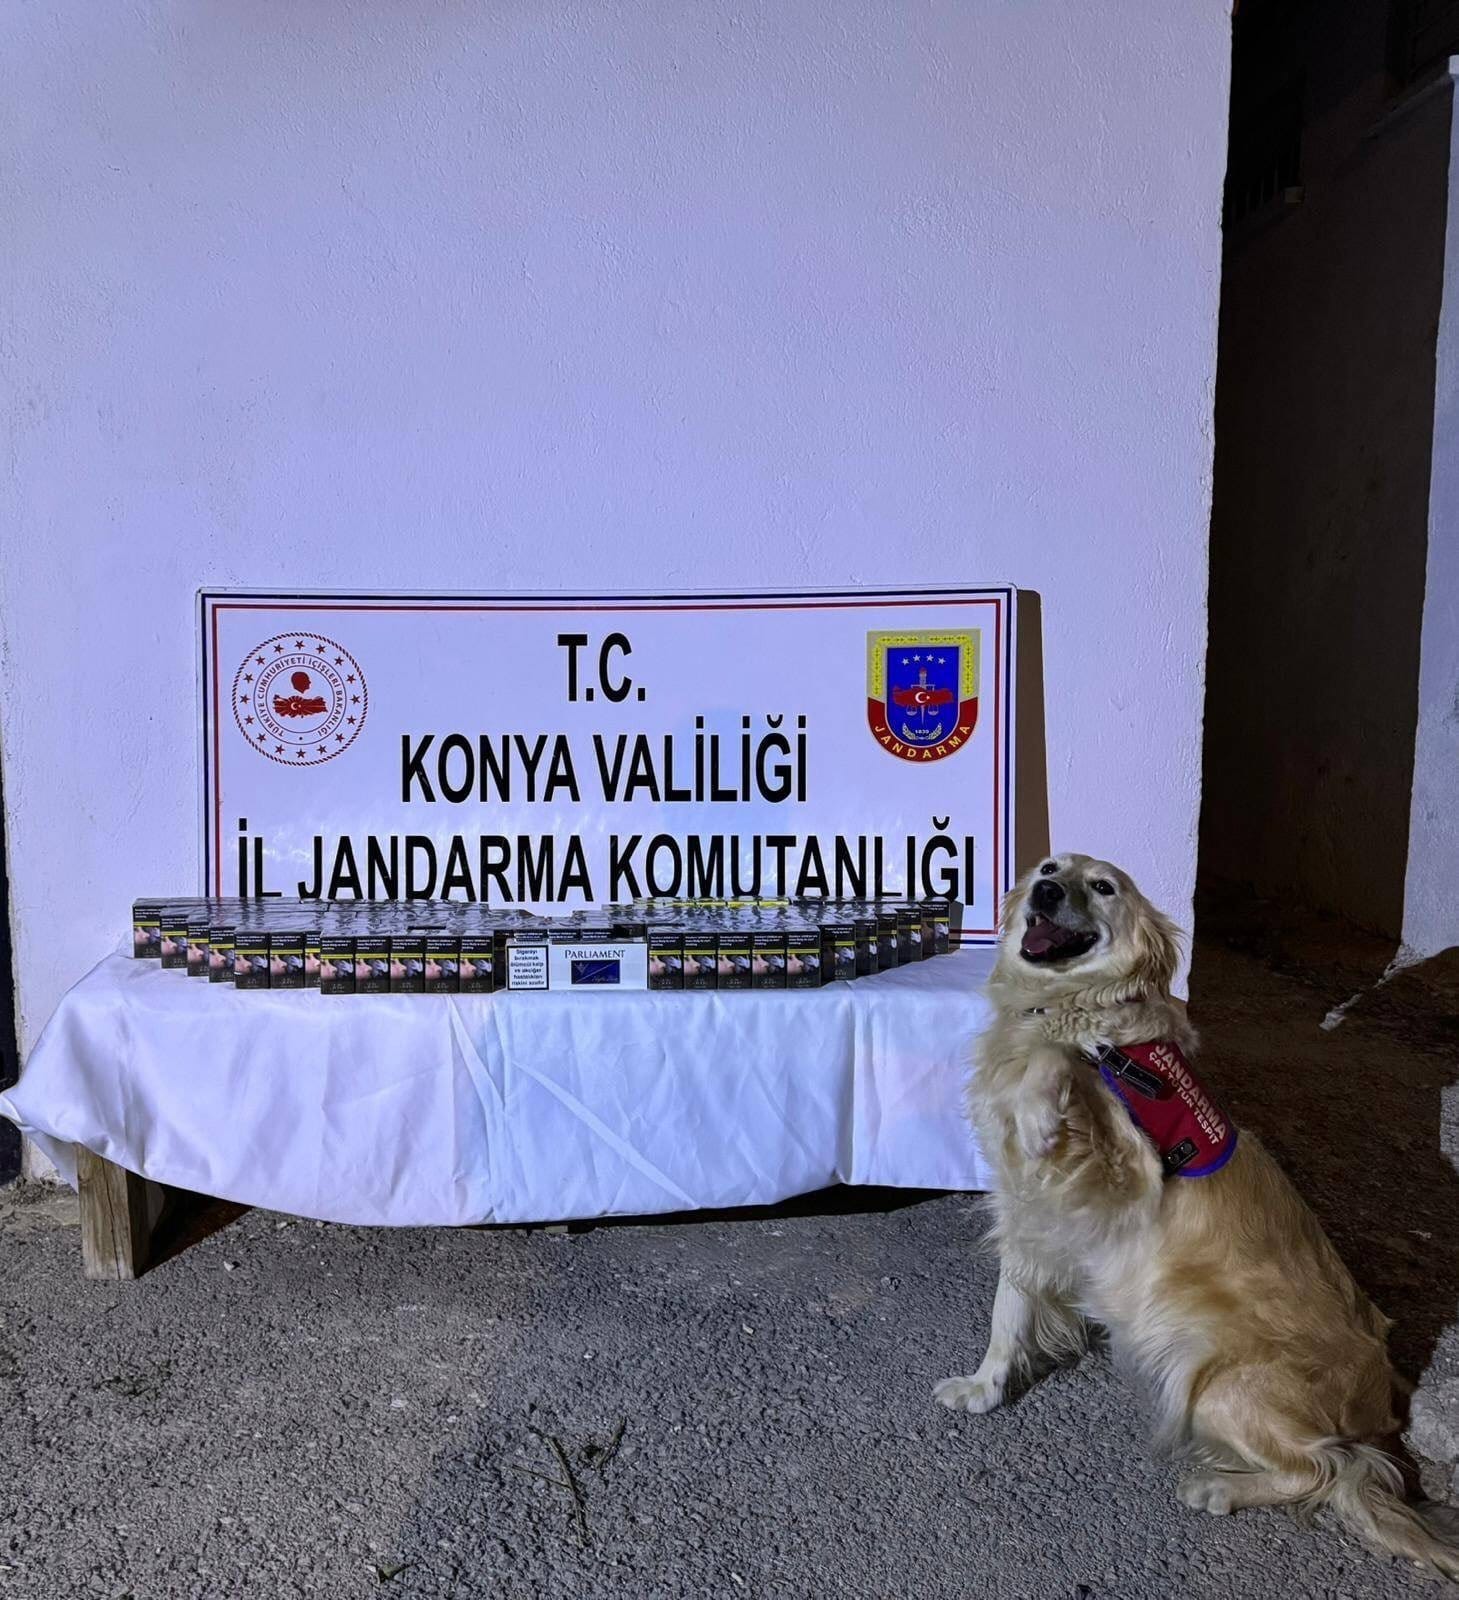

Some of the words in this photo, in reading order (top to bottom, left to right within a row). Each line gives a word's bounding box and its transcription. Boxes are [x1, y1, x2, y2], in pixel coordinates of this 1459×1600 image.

[258, 656, 306, 699] CUMHURİYETİ
[557, 632, 646, 702] T.C.
[257, 702, 283, 737] TÜRKİYE
[318, 690, 343, 737] BAKANLIĞI
[401, 733, 580, 803] KONYA
[593, 714, 806, 803] VALİLİĞİ
[874, 725, 970, 759] JANDARMA
[239, 818, 282, 897] İL
[298, 835, 594, 902] JANDARMA
[609, 816, 974, 906] KOMUTANLIĞI
[564, 949, 626, 959] PARLIAMENT
[1155, 1045, 1228, 1141] JANDARMA
